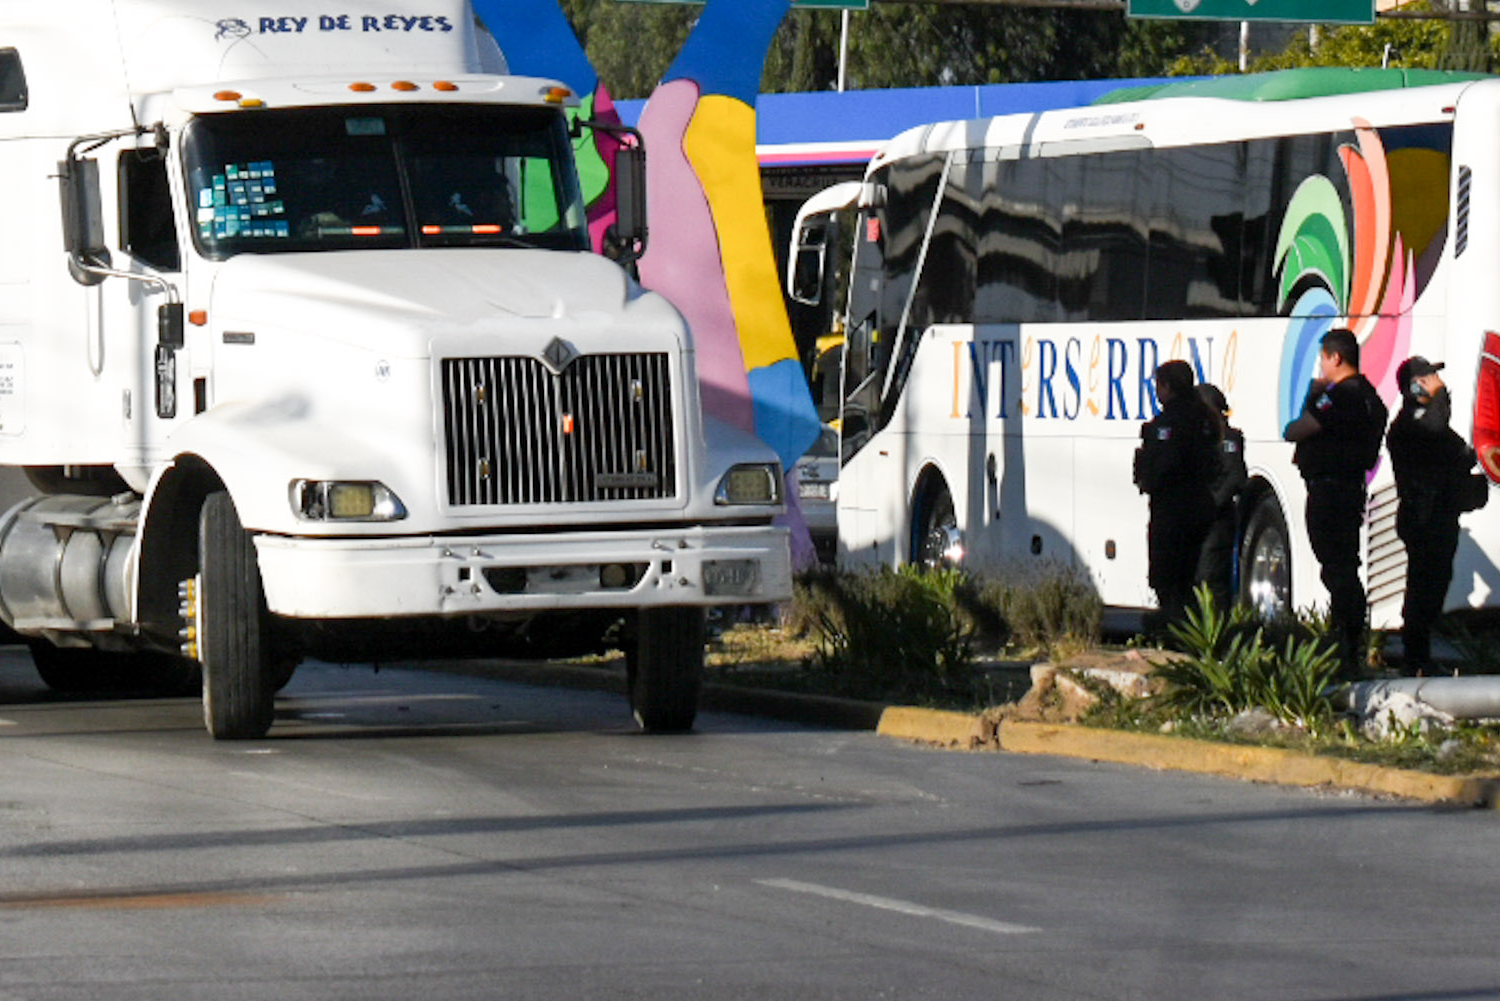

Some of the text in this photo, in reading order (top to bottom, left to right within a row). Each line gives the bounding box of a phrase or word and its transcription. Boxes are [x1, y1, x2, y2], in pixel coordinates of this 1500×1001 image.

[259, 14, 453, 34] REY DE REYES
